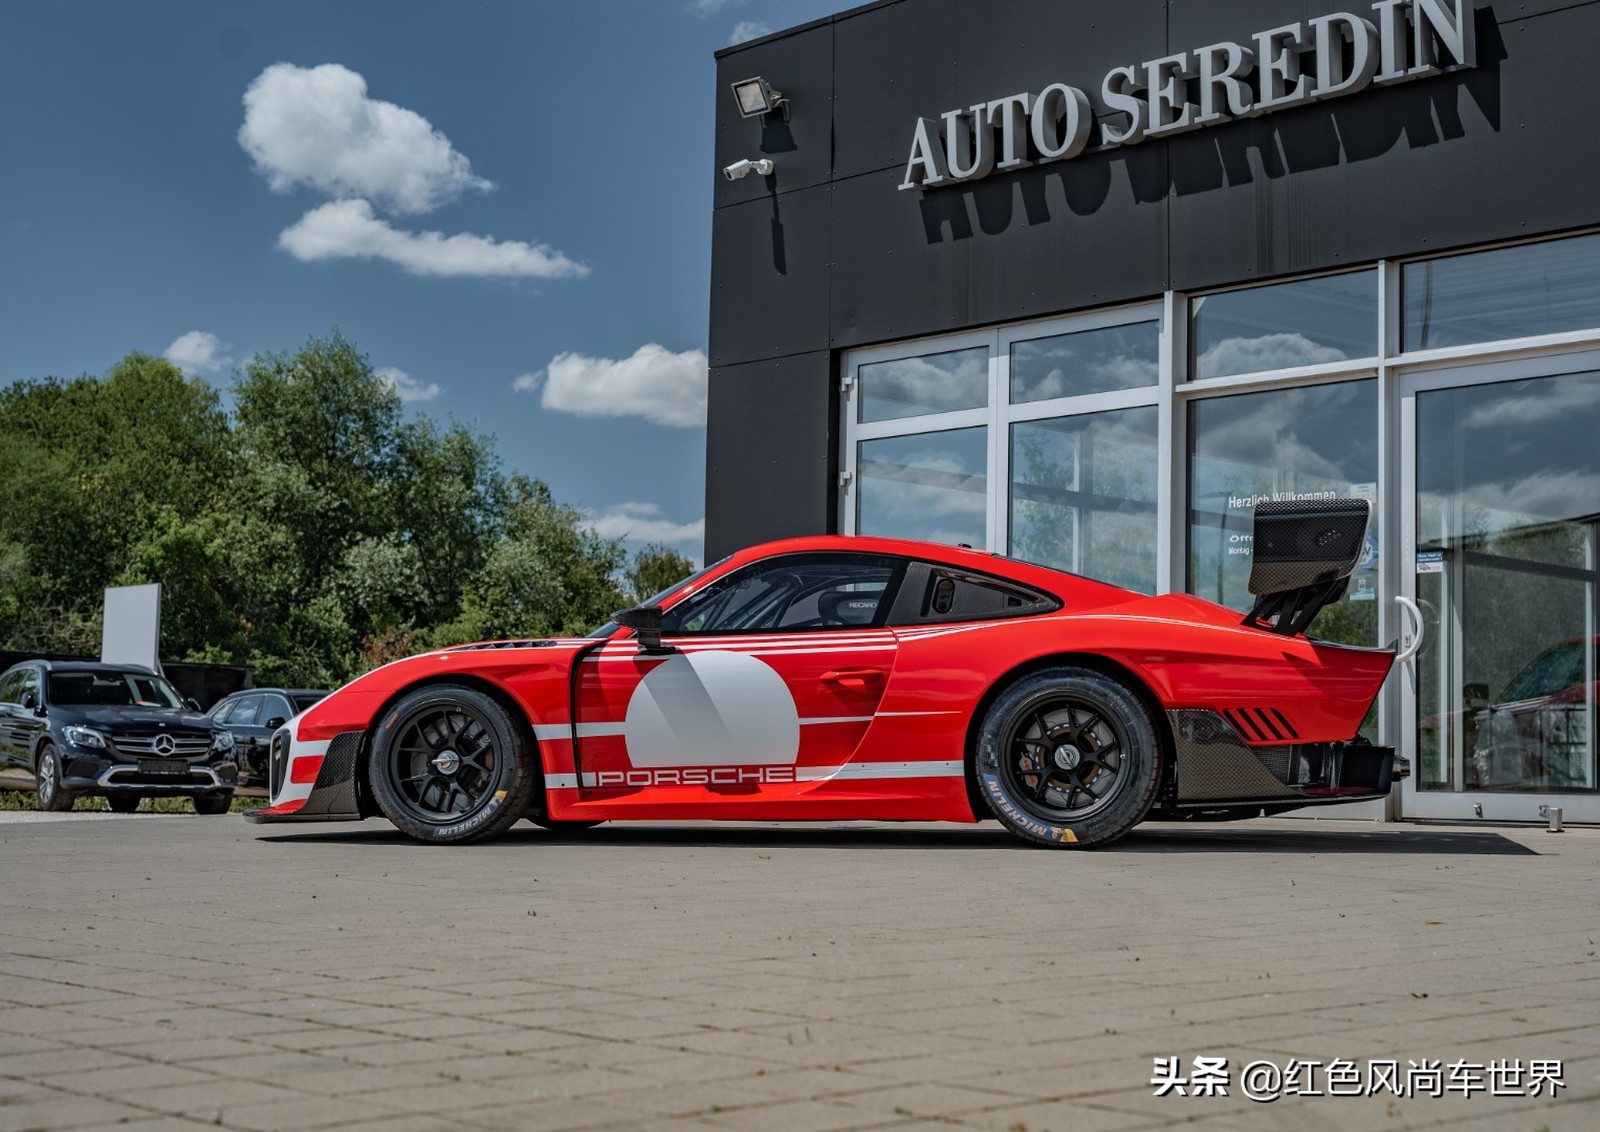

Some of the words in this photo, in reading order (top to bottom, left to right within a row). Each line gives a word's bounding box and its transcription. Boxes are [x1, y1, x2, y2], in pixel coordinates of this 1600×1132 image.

[898, 82, 1093, 191] AUTO
[1101, 0, 1476, 147] SEREDIN
[1228, 494, 1269, 508] Herzlich
[1272, 491, 1336, 502] Willkommen
[1228, 546, 1250, 556] Montag
[598, 766, 793, 787] PORSCHE
[987, 780, 1048, 836] MICHELIN
[438, 807, 492, 835] MICHELIN
